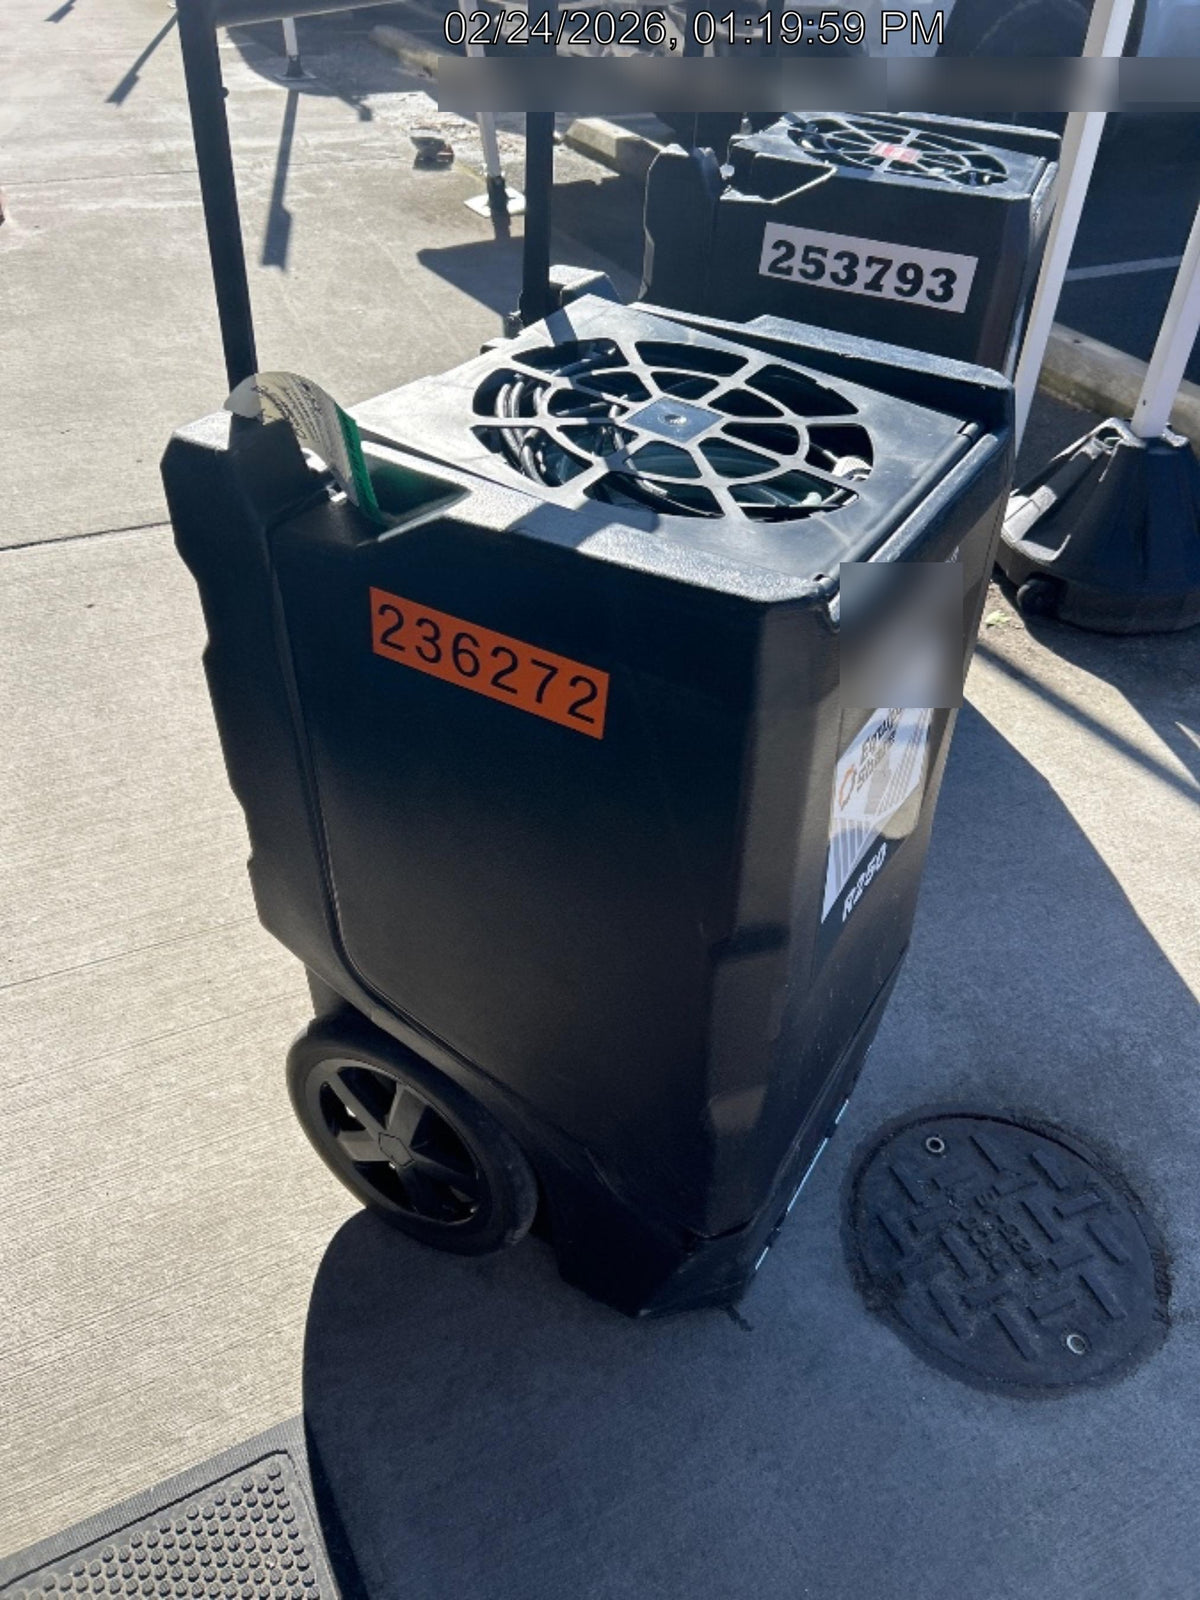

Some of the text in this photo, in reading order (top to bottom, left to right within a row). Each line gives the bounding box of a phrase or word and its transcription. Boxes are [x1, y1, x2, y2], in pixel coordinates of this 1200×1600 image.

[767, 239, 957, 303] 253793
[378, 603, 598, 724] 236272
[842, 842, 887, 922] R250
